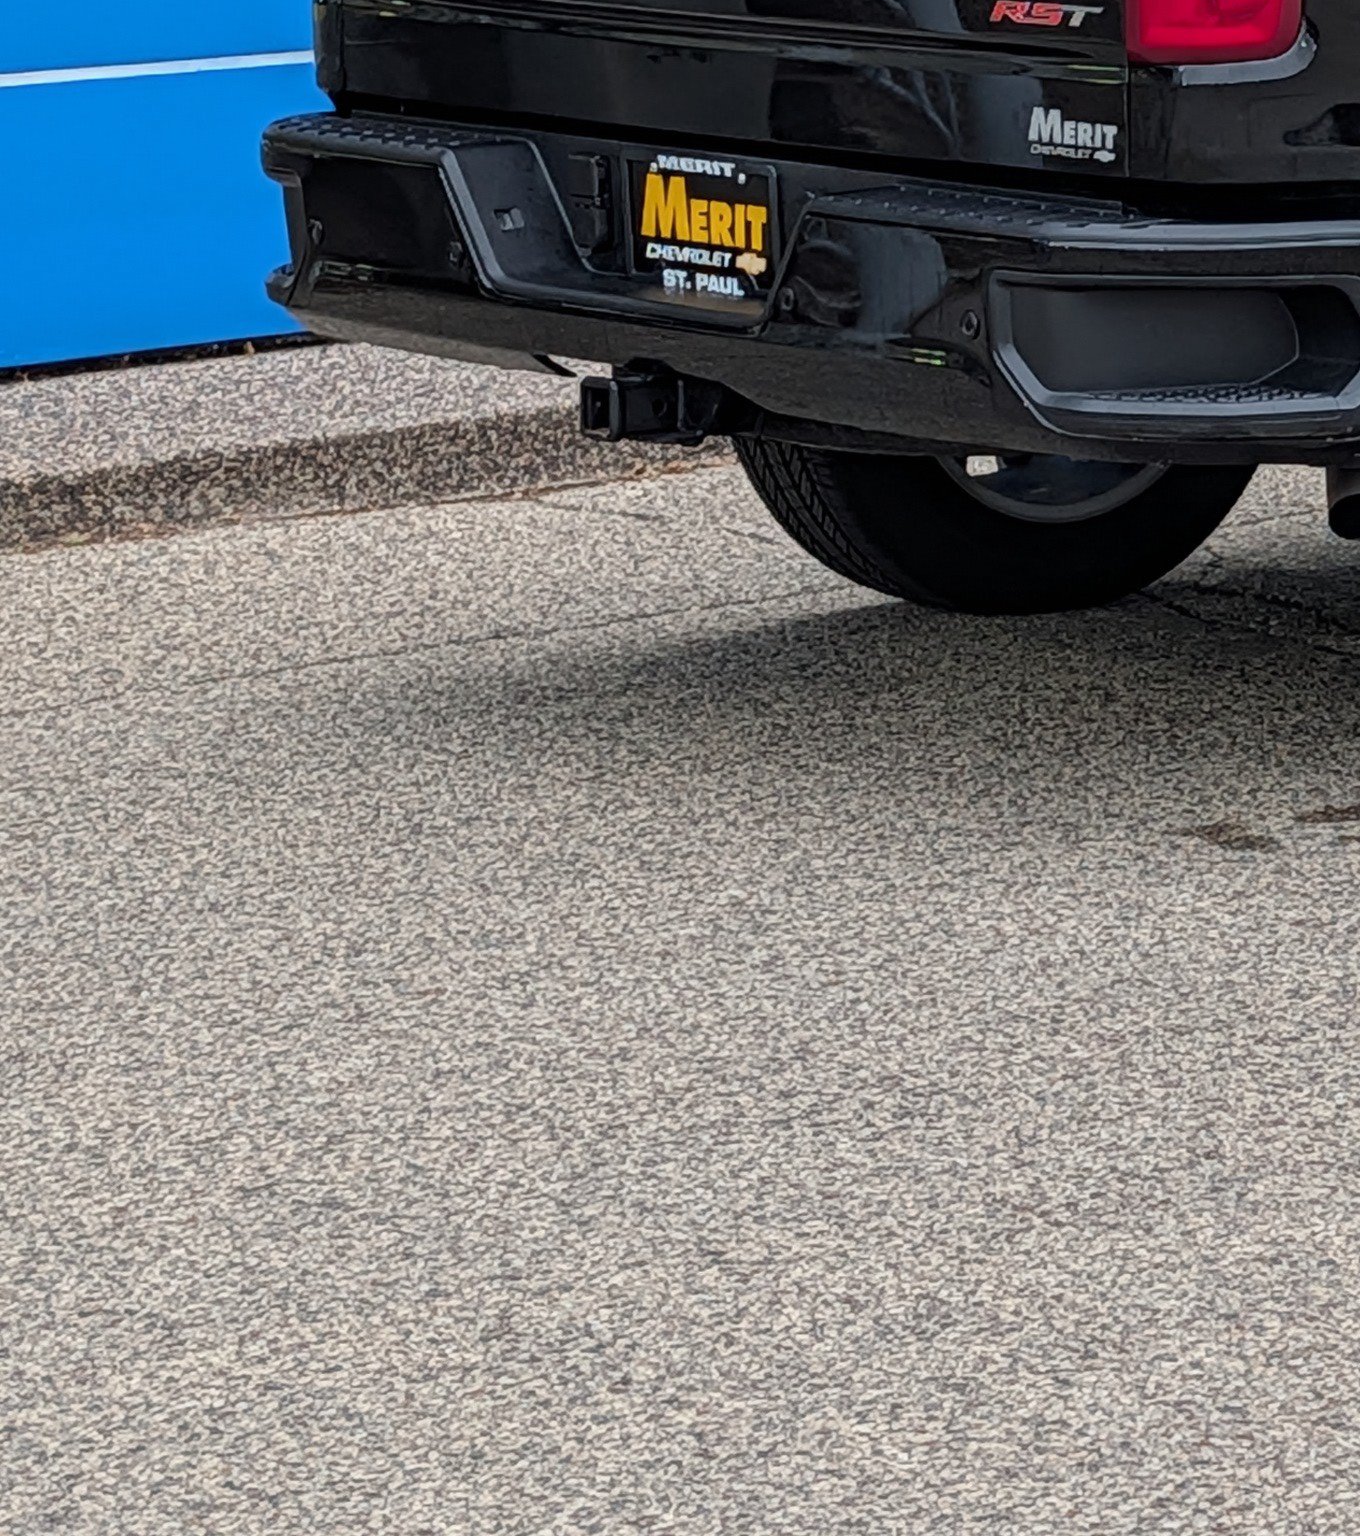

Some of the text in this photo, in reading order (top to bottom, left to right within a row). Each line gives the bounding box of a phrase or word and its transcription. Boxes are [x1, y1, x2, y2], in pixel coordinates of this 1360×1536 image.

[988, 0, 1105, 28] RST
[656, 154, 736, 178] MERIT
[645, 242, 733, 268] CHEVROLET
[662, 268, 746, 297] ST. PAUL
